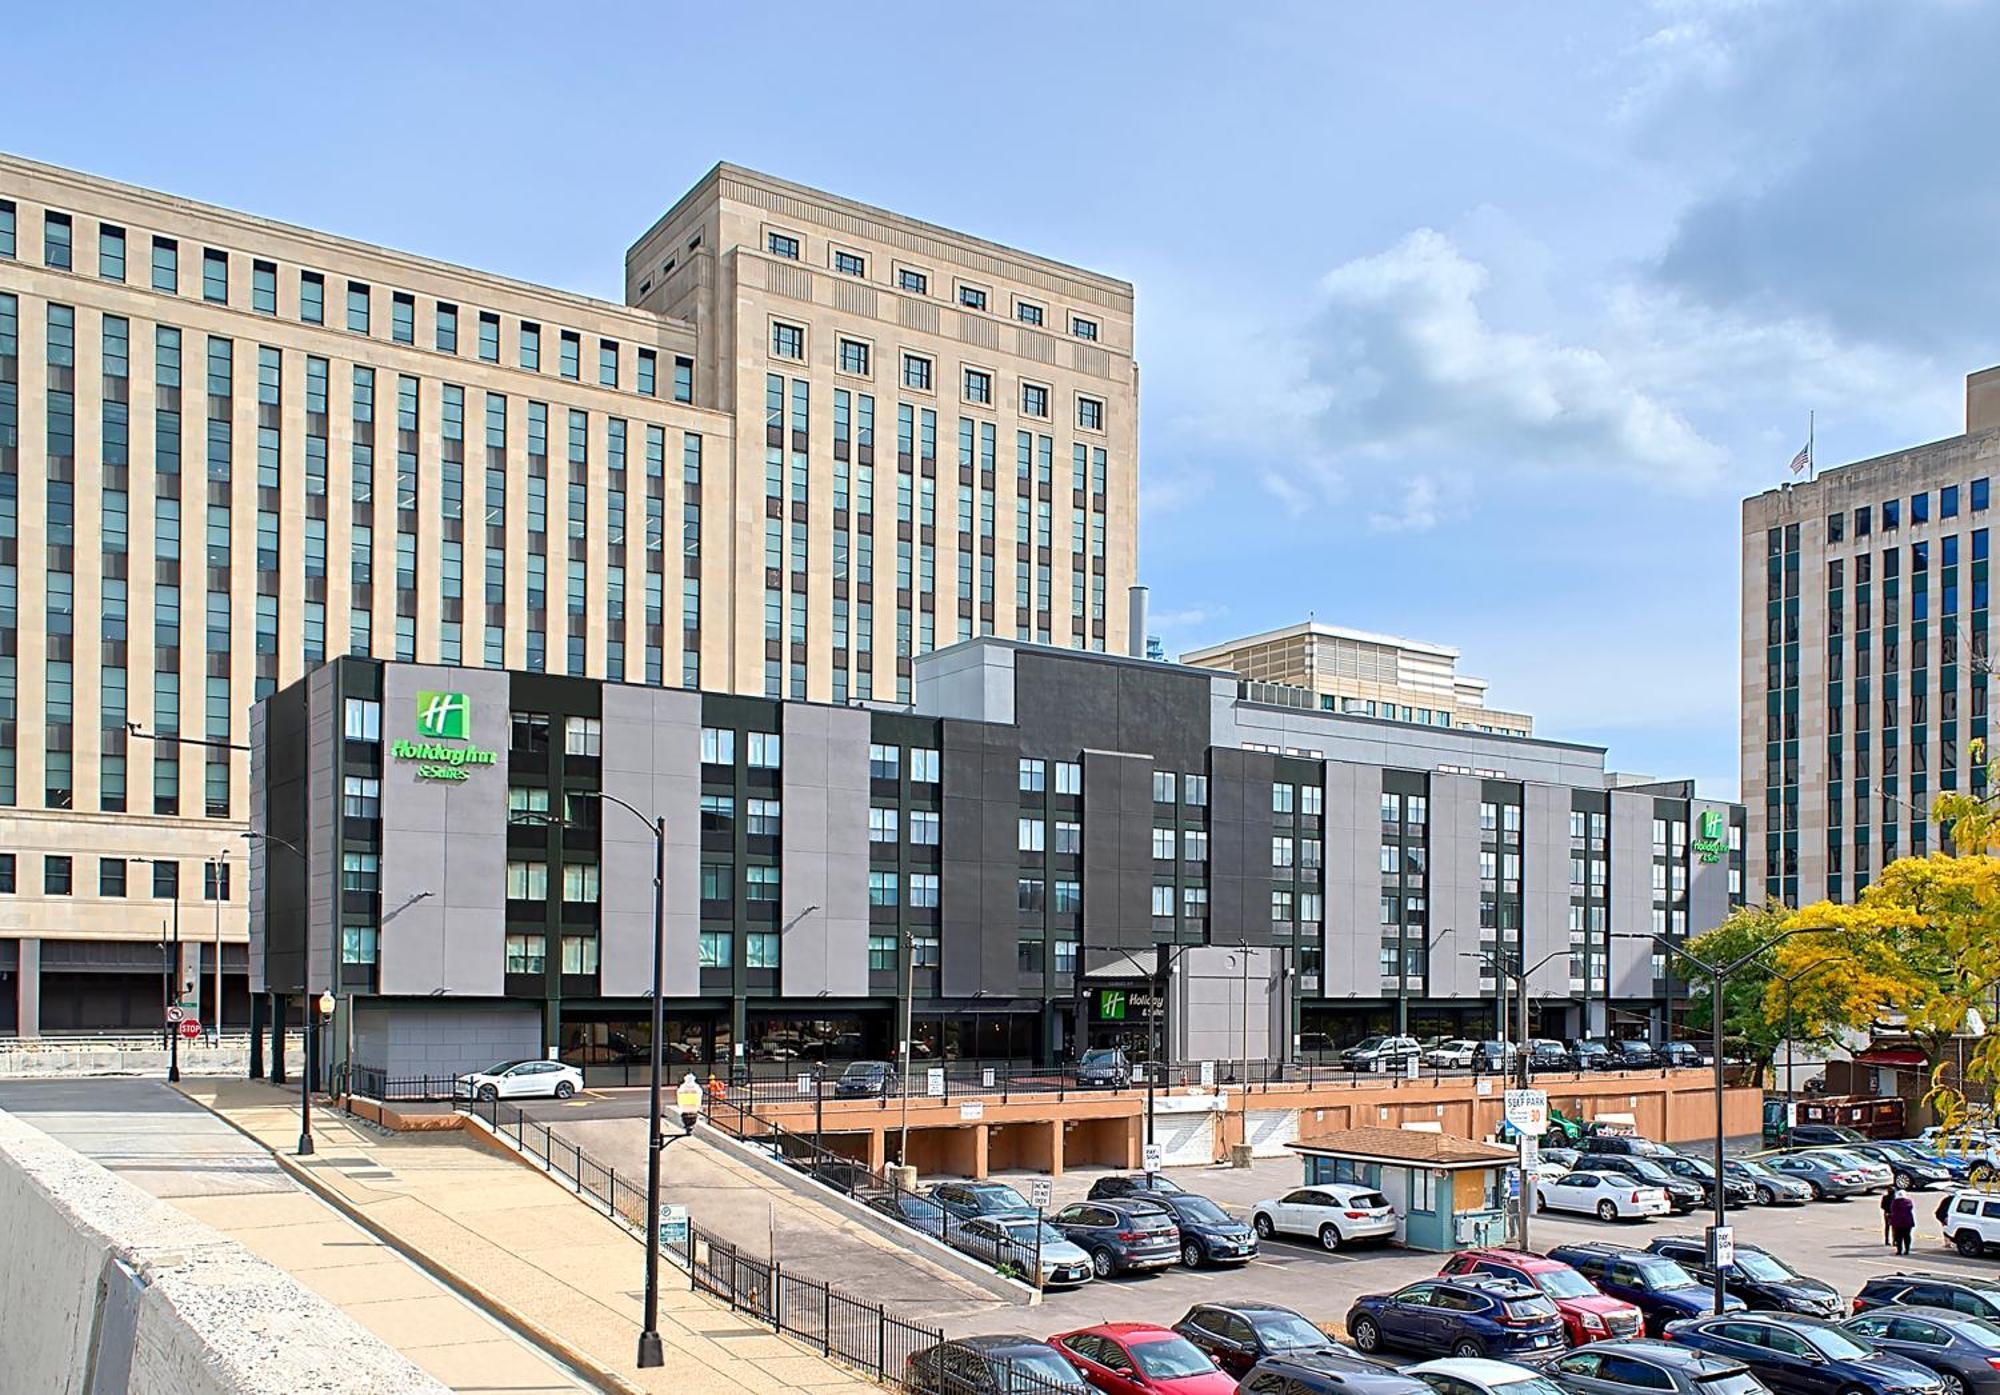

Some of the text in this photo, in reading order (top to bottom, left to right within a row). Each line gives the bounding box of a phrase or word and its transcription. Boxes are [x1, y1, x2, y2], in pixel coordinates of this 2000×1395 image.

[391, 739, 497, 765] Holiday Inn
[430, 765, 470, 780] Suites
[182, 1024, 200, 1033] STOP
[1526, 1096, 1545, 1106] PARK
